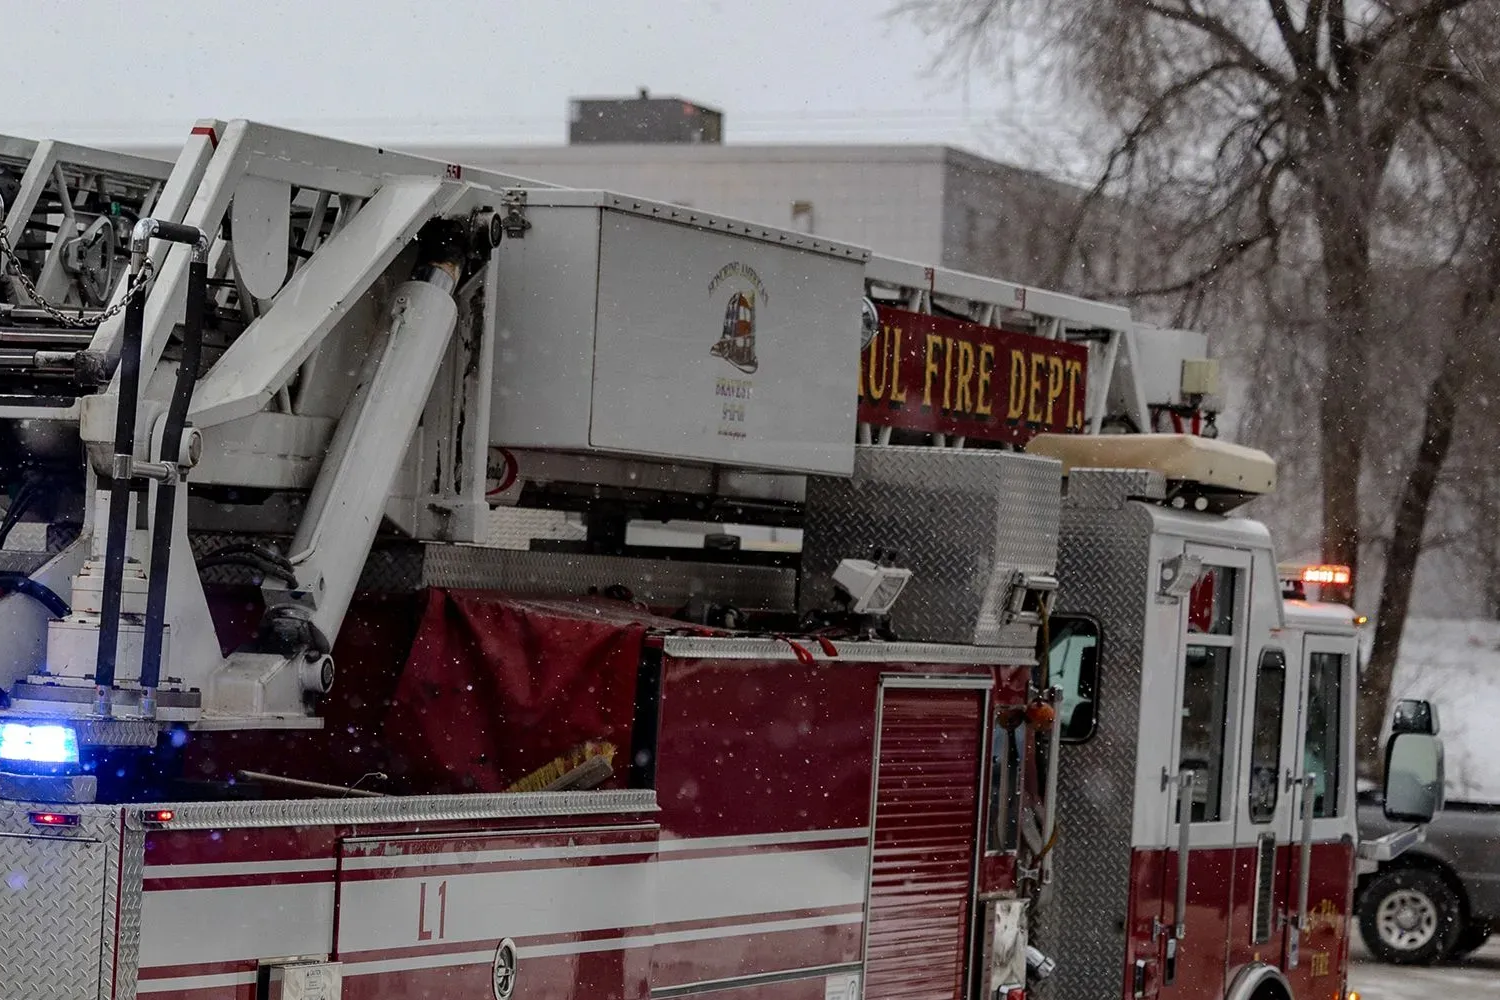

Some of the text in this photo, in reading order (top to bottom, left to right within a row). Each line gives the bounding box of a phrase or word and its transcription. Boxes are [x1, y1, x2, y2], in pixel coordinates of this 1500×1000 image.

[857, 326, 1083, 429] UL FIRE DEPT.
[418, 881, 446, 940] L1
